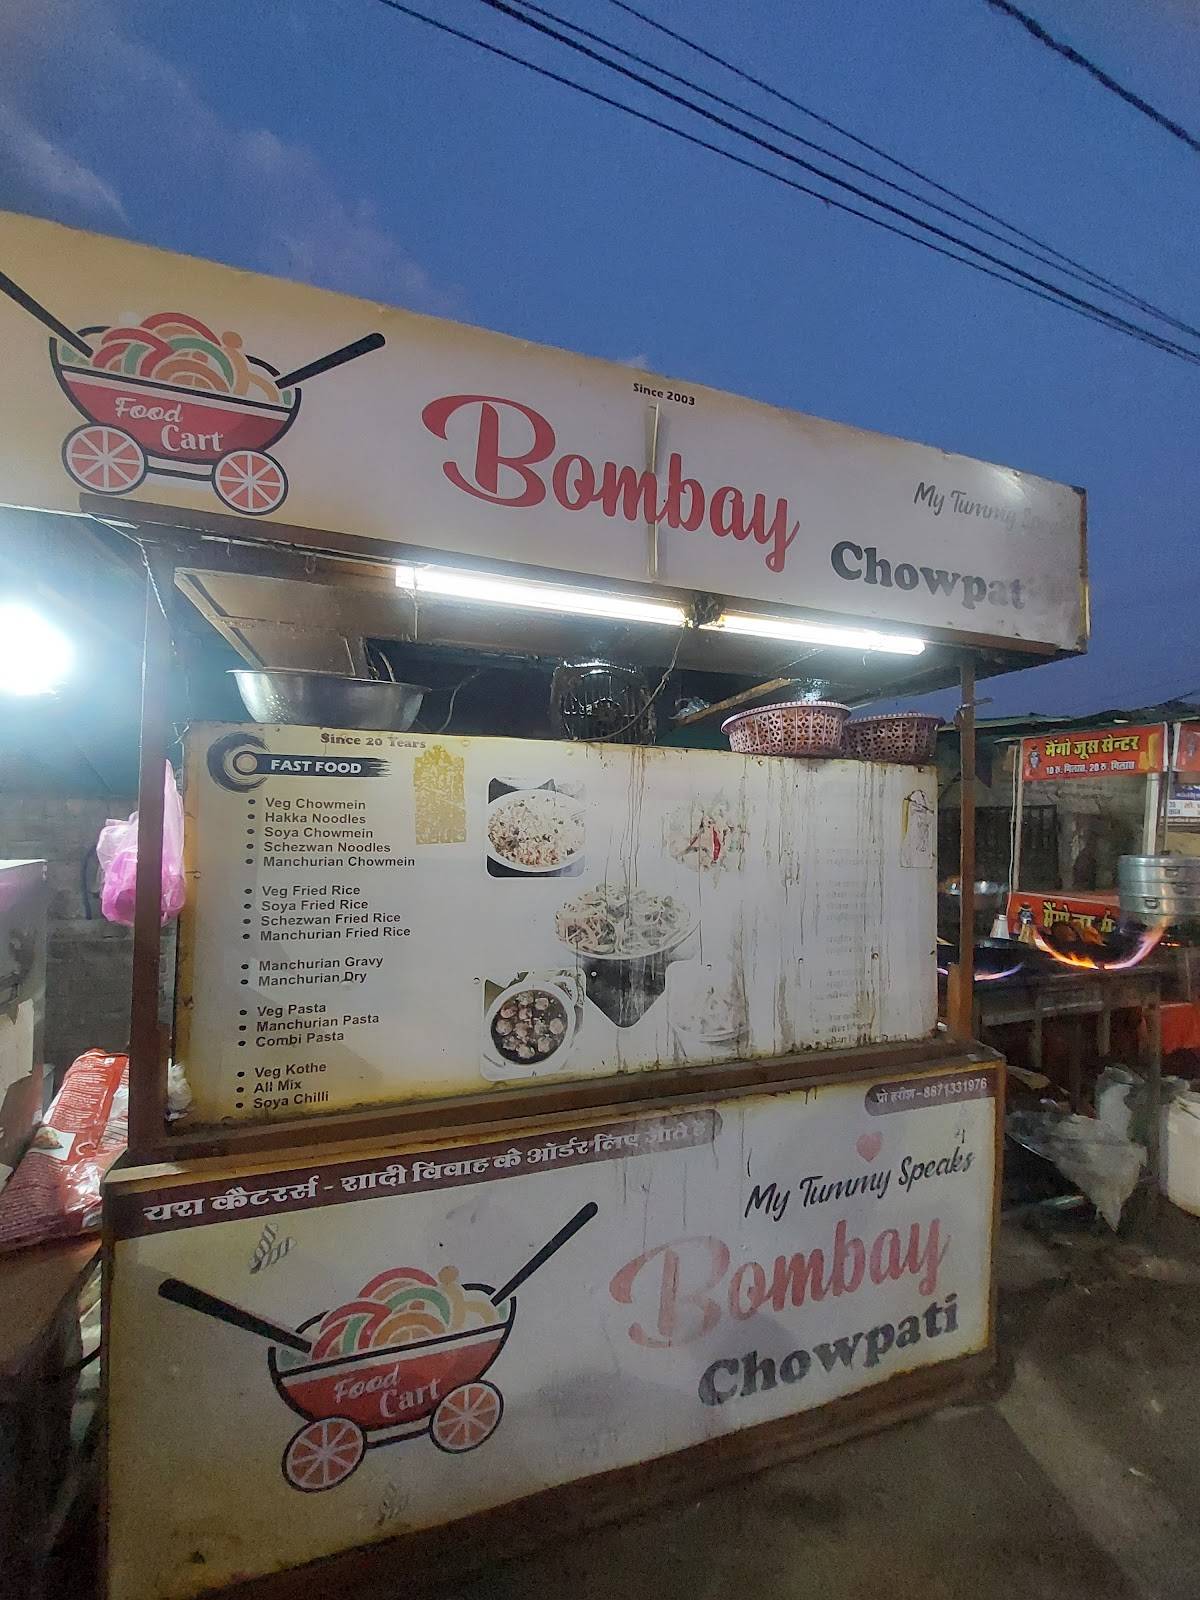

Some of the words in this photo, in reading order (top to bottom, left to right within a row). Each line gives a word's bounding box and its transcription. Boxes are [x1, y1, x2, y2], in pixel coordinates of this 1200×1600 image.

[633, 383, 664, 398] Since
[667, 391, 695, 406] 2003
[114, 397, 183, 423] Food
[161, 424, 224, 452] Cart
[421, 394, 800, 572] Bombay
[913, 481, 945, 516] My
[831, 541, 1026, 610] Chowpat
[320, 732, 361, 746] Since
[366, 737, 383, 747] 20
[1073, 739, 1100, 760] जूस
[1101, 734, 1140, 753] सेन्टर
[271, 759, 312, 772] FAST
[315, 761, 362, 774] FOOD
[1089, 763, 1099, 772] 20
[265, 797, 292, 810] Veg
[296, 798, 366, 810] Chowmein
[265, 812, 307, 824] Hakka
[313, 813, 366, 824] Noodles
[264, 827, 298, 841] Soya
[303, 827, 373, 839] Chowmein
[263, 841, 333, 853] Schezwan
[338, 842, 391, 853] Noodles
[263, 856, 343, 867] Manchurian
[348, 856, 415, 867] Chowmein
[262, 886, 288, 899] Veg
[293, 885, 327, 896] Fried
[331, 885, 360, 896] Rice
[261, 900, 296, 914] Soya
[301, 900, 335, 910] Fried
[340, 899, 369, 910] Rice
[261, 915, 330, 927] Schezwan
[335, 914, 369, 924] Fried
[373, 912, 401, 923] Rice
[260, 929, 341, 941] Manchurian
[346, 927, 379, 938] Fried
[383, 926, 411, 937] Rice
[259, 957, 340, 971] Manchurian
[344, 956, 383, 969] Gravy
[258, 973, 340, 986] Manchurian
[344, 971, 367, 984] Dry
[257, 1006, 283, 1018] Veg
[288, 1003, 326, 1015] Pasta
[256, 1017, 338, 1032] Manchurian
[343, 1013, 379, 1026] Pasta
[256, 1033, 302, 1048] Combi
[306, 1031, 344, 1043] Pasta
[254, 1066, 281, 1079] Veg
[286, 1062, 327, 1075] Kothe
[253, 1081, 273, 1093] All
[278, 1079, 302, 1091] Mix
[253, 1096, 289, 1110] Soya
[294, 1091, 329, 1105] Chilli
[340, 1164, 407, 1192] शादी
[412, 1156, 489, 1182] विवाह
[493, 1148, 523, 1169] के
[744, 1183, 790, 1222] My
[800, 1169, 891, 1208] Tummy
[898, 1146, 976, 1192] Speaks
[609, 1218, 951, 1348] Bombay
[698, 1293, 959, 1406] Chowpati
[334, 1364, 399, 1403] Food
[379, 1378, 440, 1418] Cart
